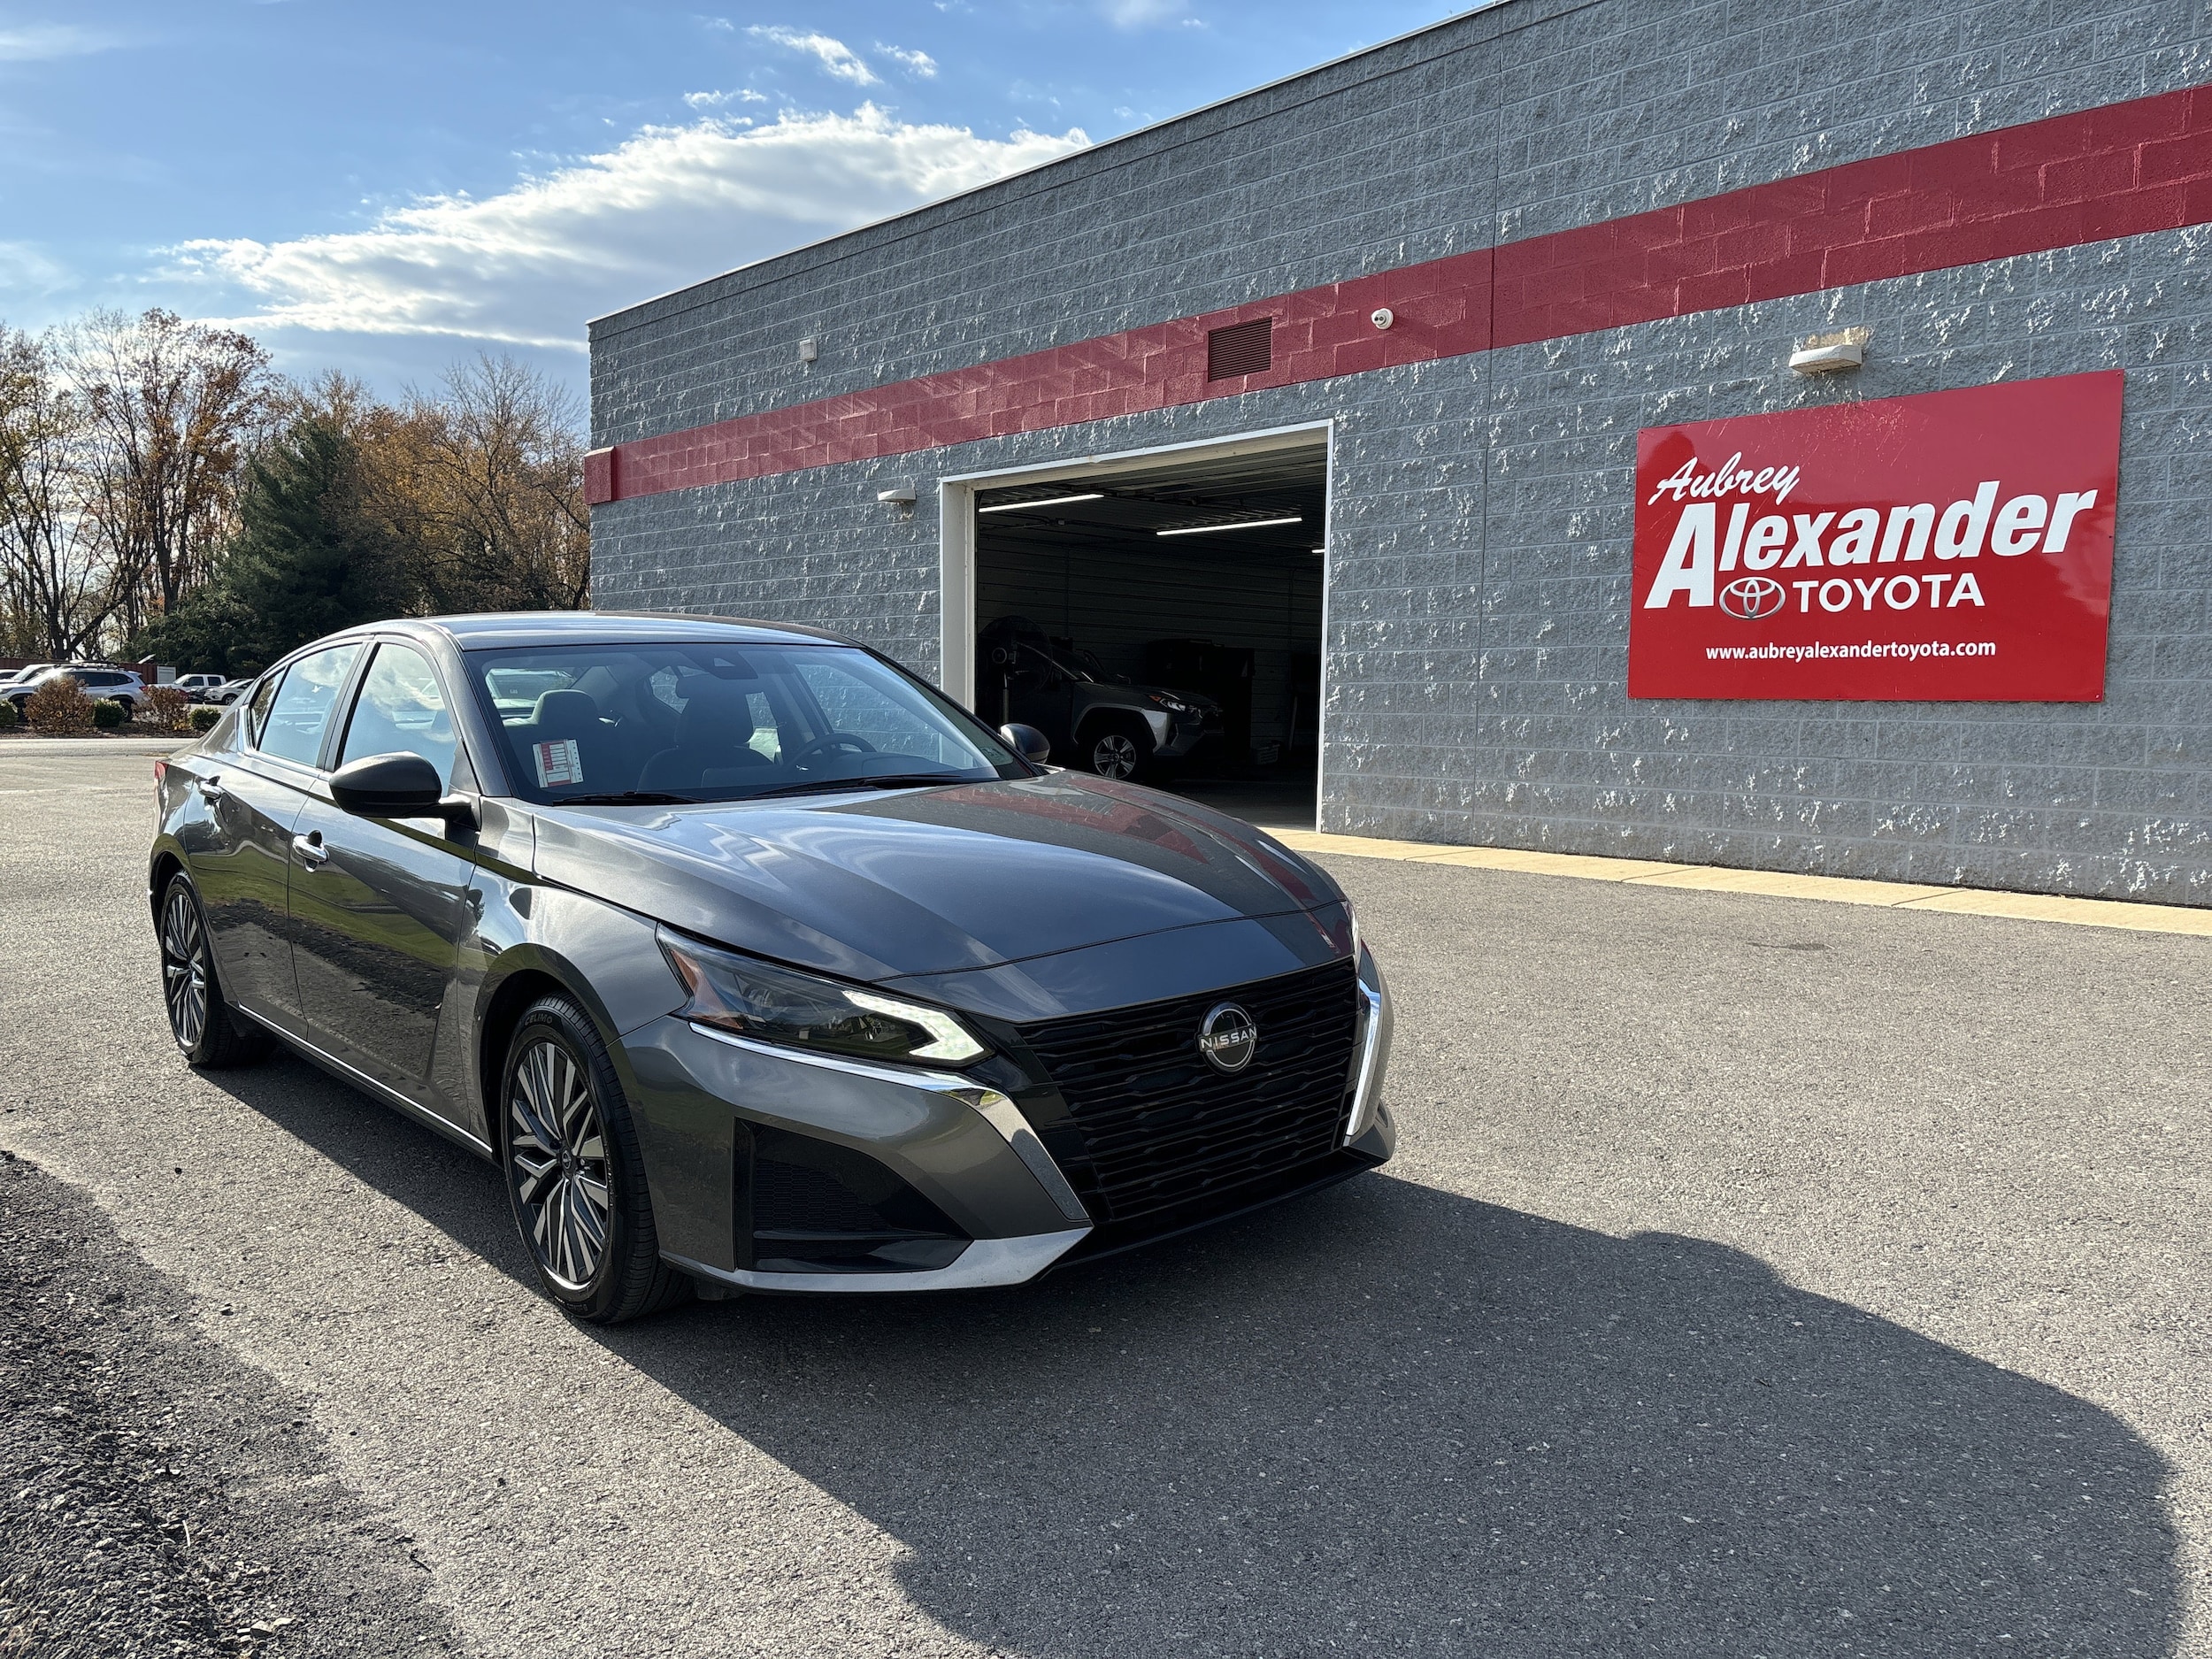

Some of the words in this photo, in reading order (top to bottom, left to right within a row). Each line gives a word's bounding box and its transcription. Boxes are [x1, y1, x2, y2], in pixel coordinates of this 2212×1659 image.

[1647, 451, 1801, 506] Aubrey
[1643, 480, 2099, 610] Alexander
[1792, 572, 1985, 613] TOYOTA
[1706, 640, 1996, 663] www.aubreyalexandertoyota.com
[1200, 1025, 1257, 1049] NISSAN
